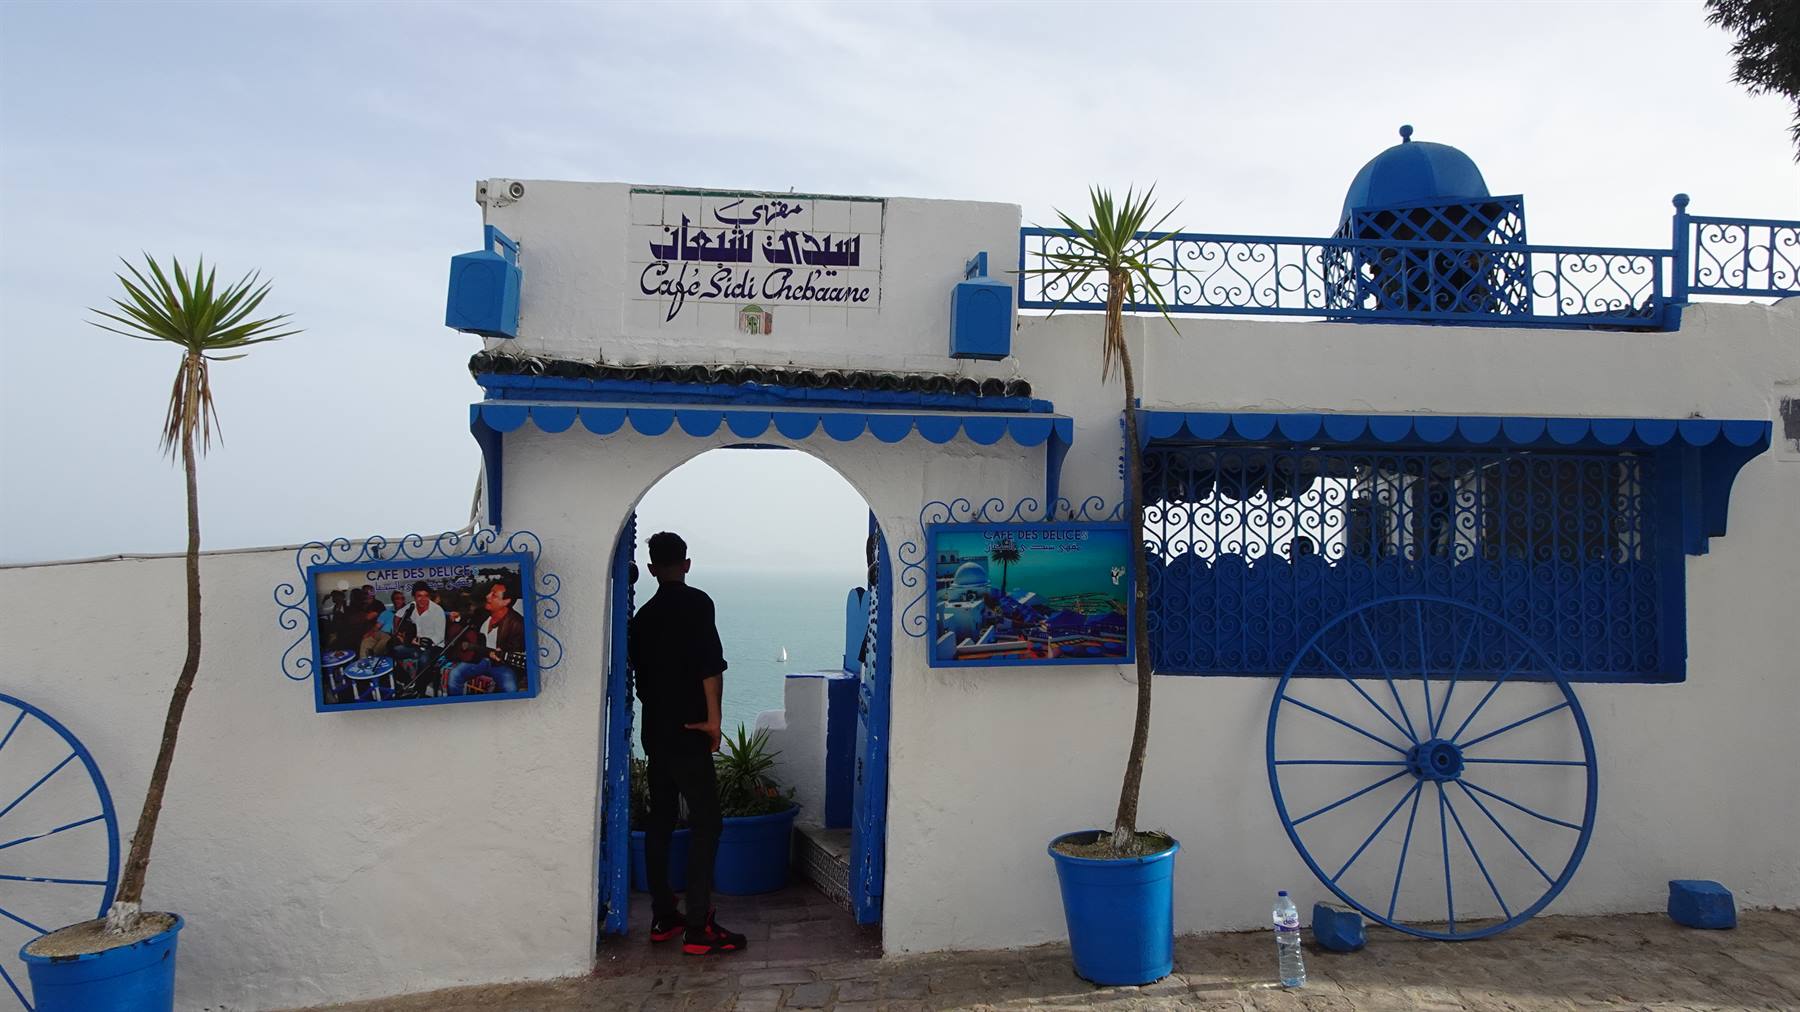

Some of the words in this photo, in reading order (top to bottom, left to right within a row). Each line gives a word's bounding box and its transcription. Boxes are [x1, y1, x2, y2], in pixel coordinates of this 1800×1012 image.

[714, 199, 803, 226] مقهى
[640, 260, 701, 323] Café
[700, 263, 758, 300] Sidi
[984, 529, 1013, 541] CAFE
[1018, 529, 1038, 540] DES
[366, 569, 399, 581] CAFE
[403, 567, 425, 579] DES
